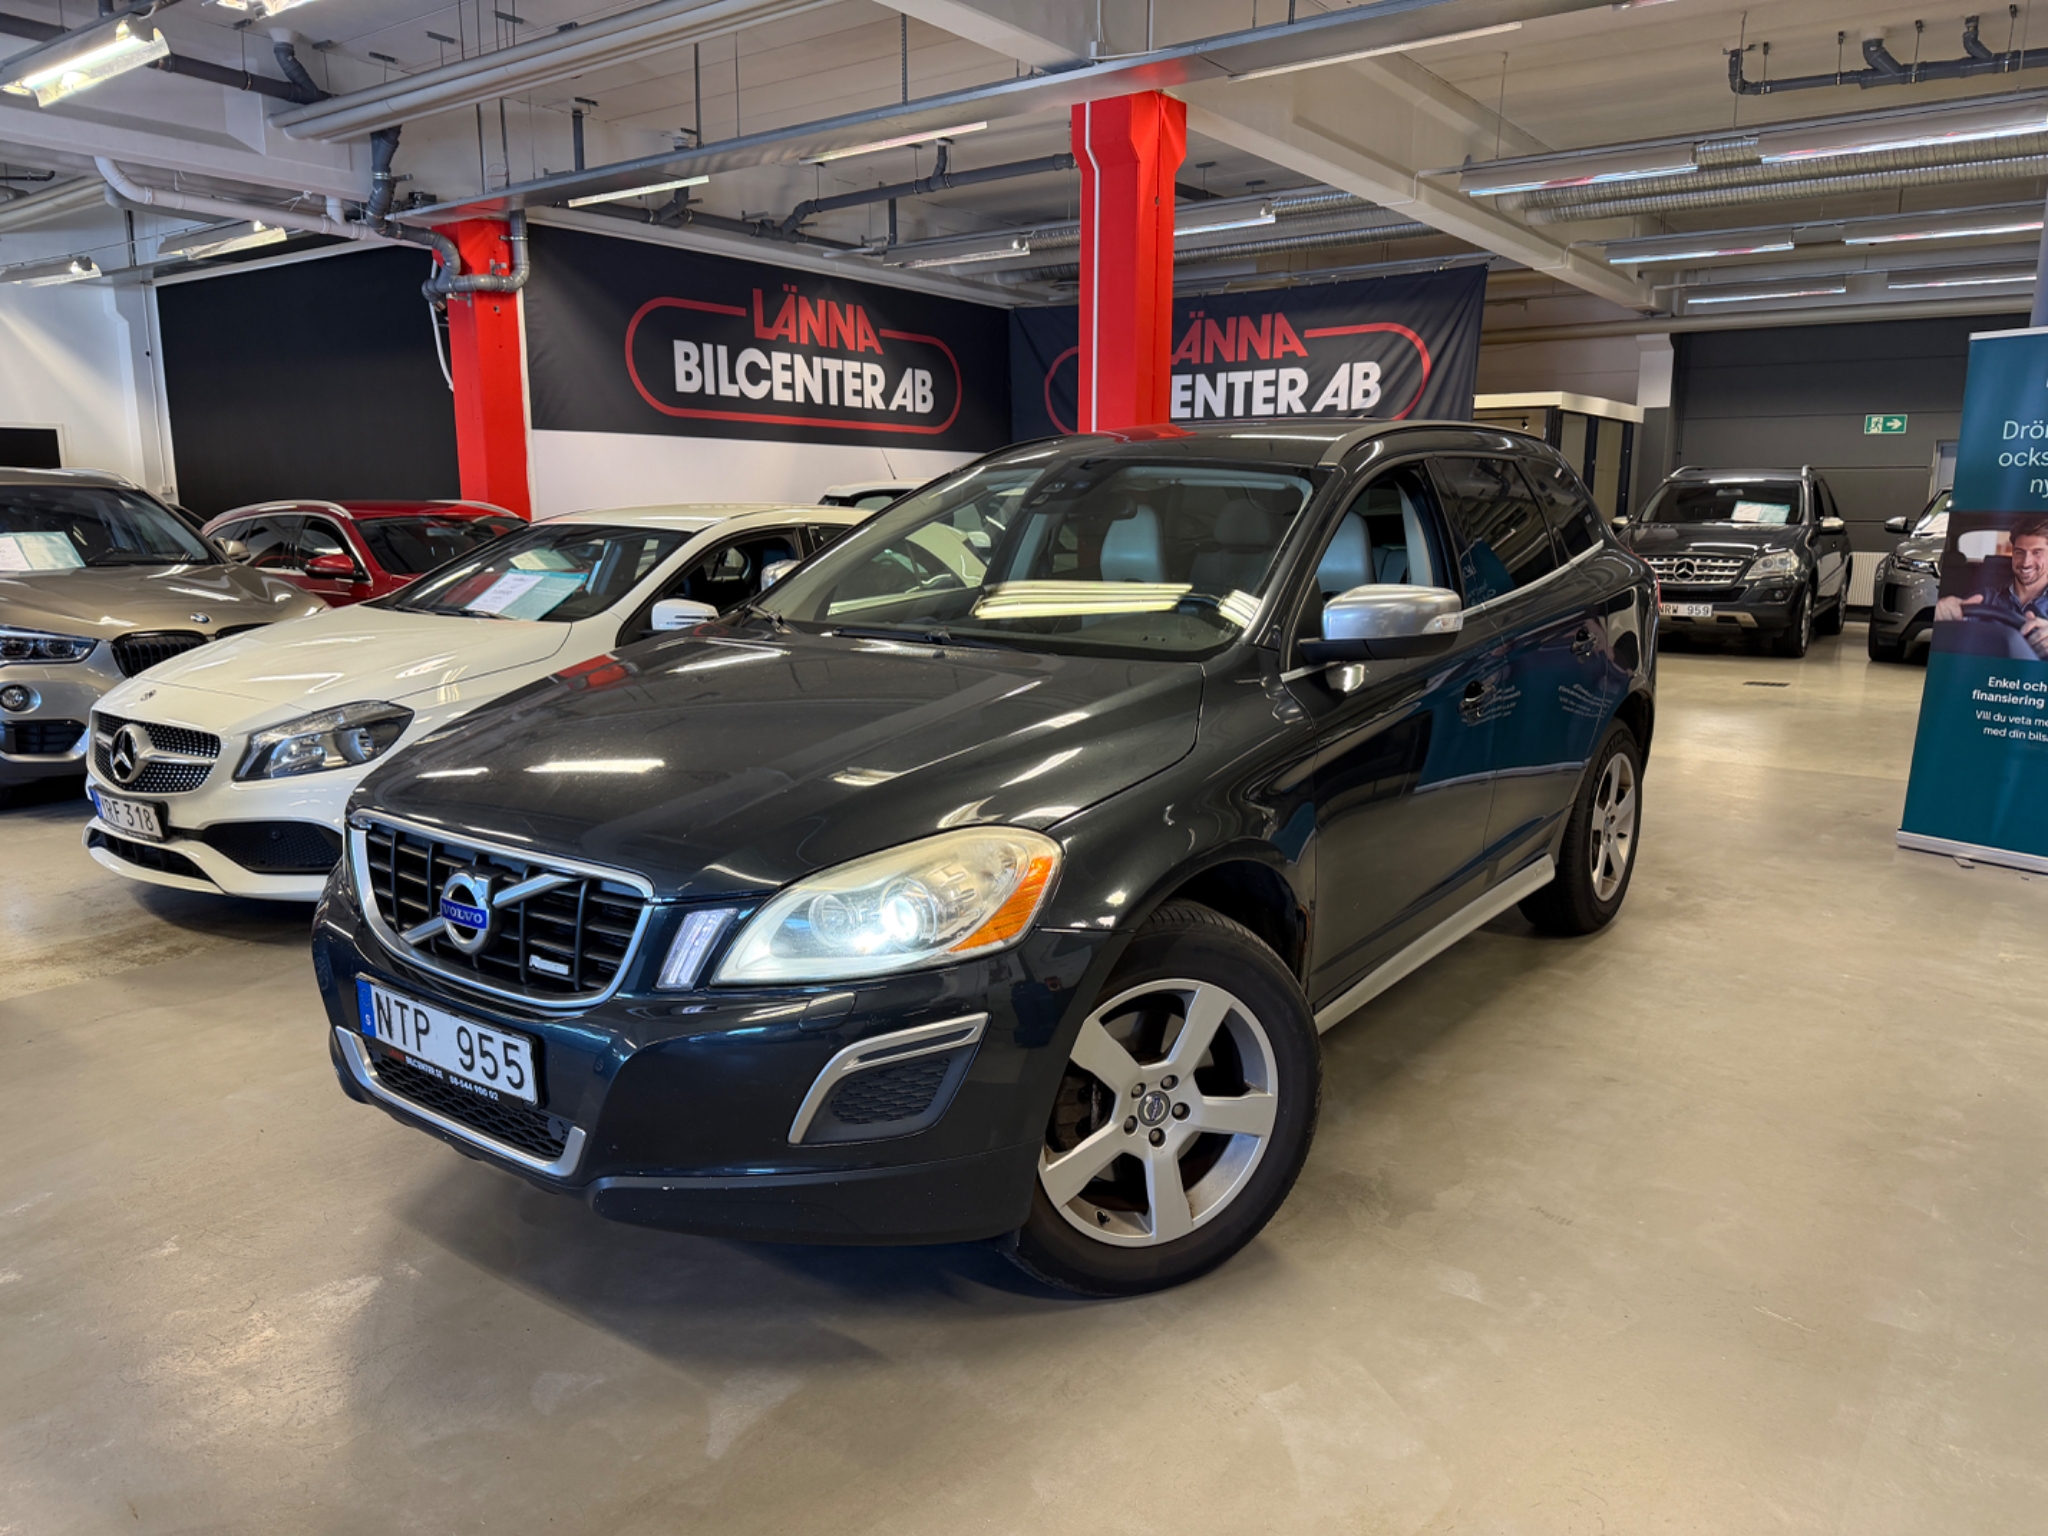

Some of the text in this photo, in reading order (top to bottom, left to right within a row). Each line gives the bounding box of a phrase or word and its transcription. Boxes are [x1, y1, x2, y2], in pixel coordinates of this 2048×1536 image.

[752, 284, 884, 355] LÄNNA
[1171, 310, 1309, 366] ÄNNA
[673, 339, 935, 414] BILCENTER AB
[1171, 361, 1382, 419] ENTER AB
[2002, 420, 2048, 441] Drö
[1687, 605, 1709, 616] 959
[1988, 676, 2047, 692] Enkel och
[1972, 689, 2045, 709] finansiering
[1975, 709, 1991, 720] Vill
[1993, 712, 2007, 722] du
[2008, 715, 2032, 726] veta
[1983, 726, 2048, 742] med din bils
[123, 803, 154, 832] 318
[442, 902, 483, 924] VOLVO
[365, 1014, 372, 1026] S
[375, 991, 525, 1090] NTP 955
